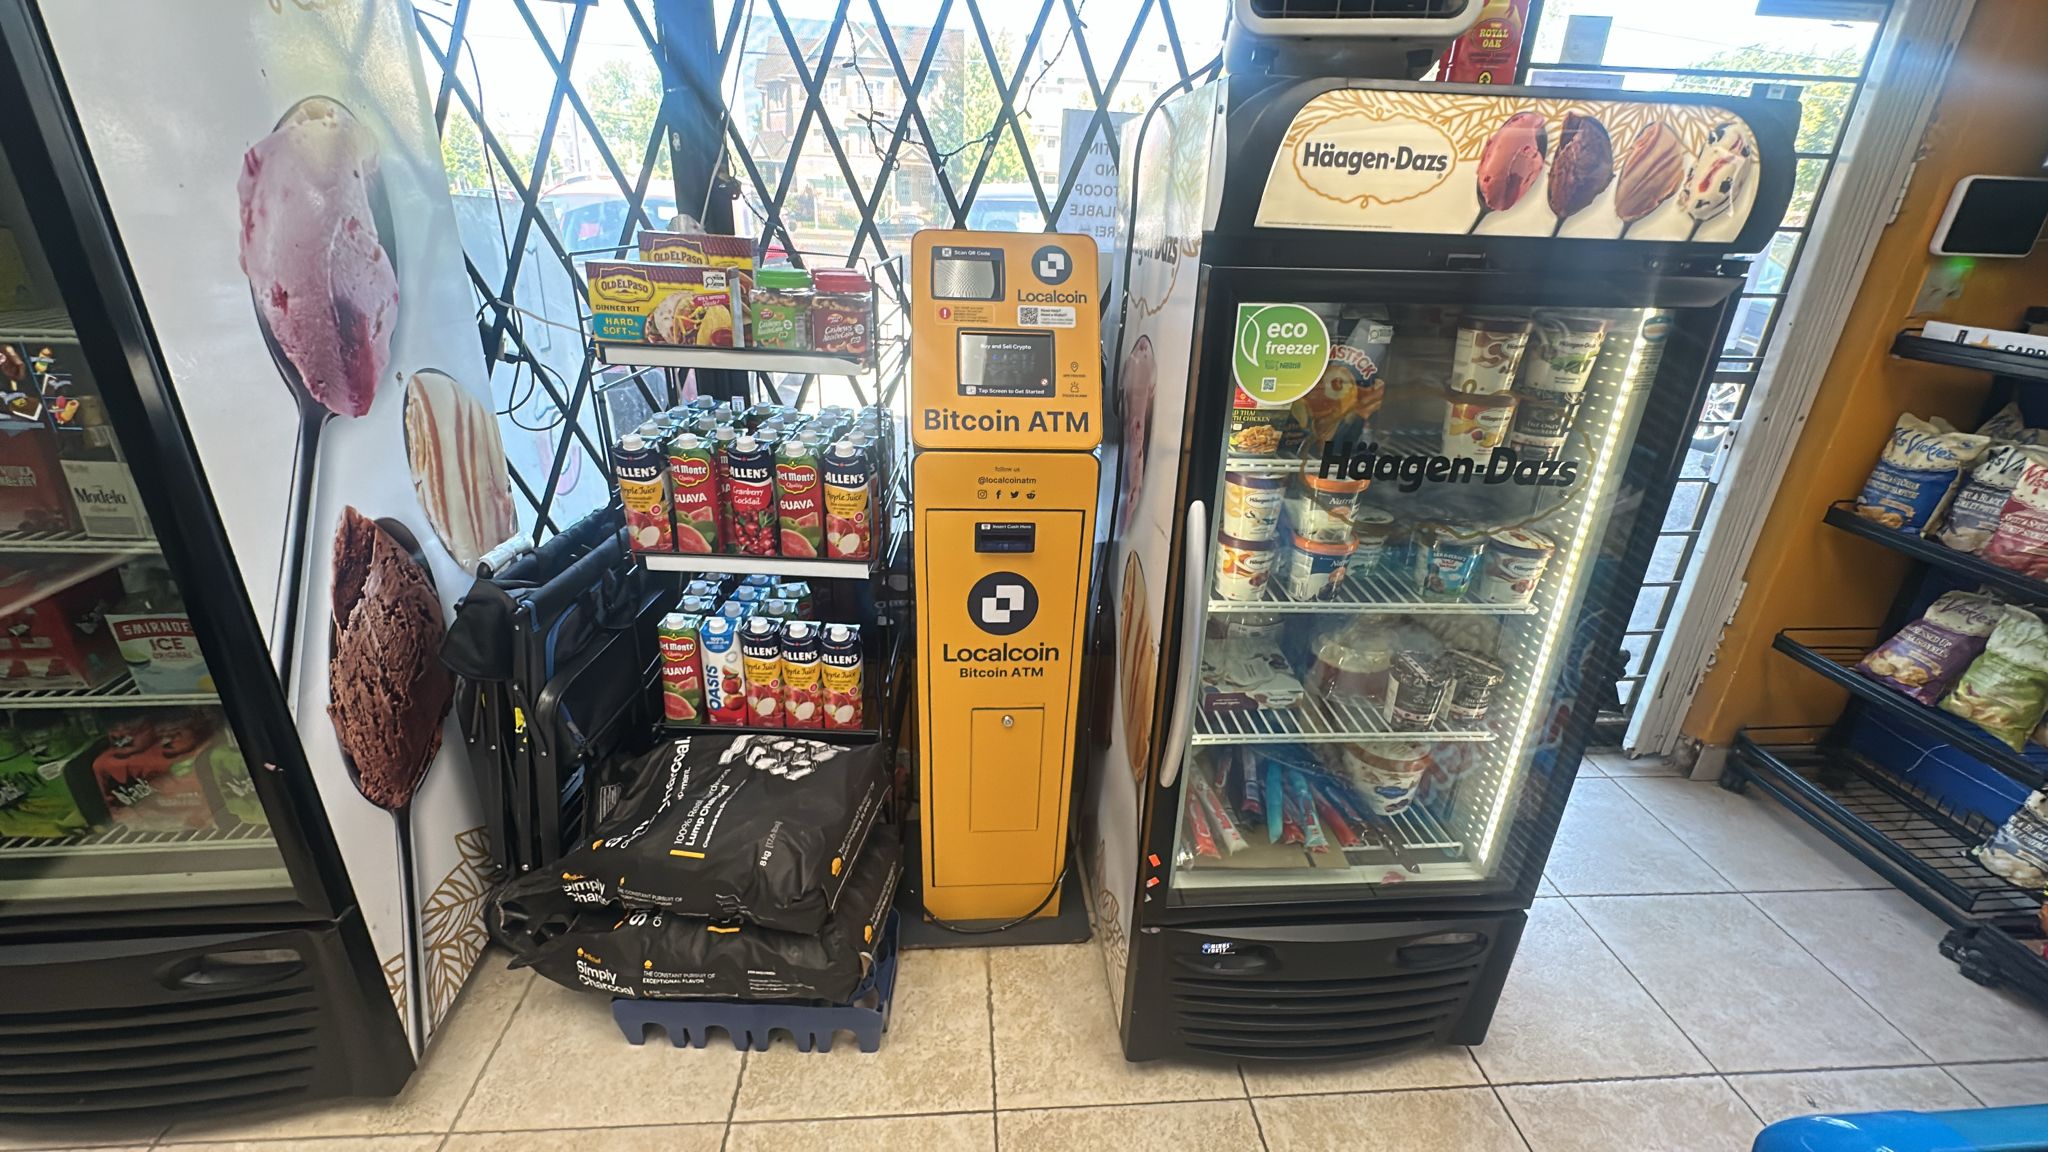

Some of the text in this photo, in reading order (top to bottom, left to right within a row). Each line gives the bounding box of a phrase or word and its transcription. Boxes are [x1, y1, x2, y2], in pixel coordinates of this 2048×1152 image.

[1480, 29, 1509, 38] ROYAL
[1482, 39, 1502, 48] OAK
[1302, 142, 1448, 175] Häagen-Dazs
[601, 280, 619, 292] OLD
[618, 279, 629, 289] EL
[1017, 289, 1088, 304] Localcoin
[595, 304, 640, 313] DINNER KIT
[605, 317, 634, 326] HARD
[603, 326, 627, 335] SOFT
[1266, 322, 1309, 338] eco
[1265, 340, 1320, 356] freezer
[924, 408, 1089, 433] Bitcoin ATM
[616, 465, 657, 478] ALLEN'S
[681, 465, 707, 475] Monte
[729, 466, 768, 479] ALLEN'S
[1319, 441, 1579, 493] Häagen-Dazs
[788, 471, 815, 482] Monte
[825, 472, 865, 484] ALLEN'S
[977, 477, 1037, 485] @localcoinatm
[74, 487, 128, 505] Modelo
[639, 485, 656, 495] Juice
[733, 486, 764, 497] Cranberry
[674, 492, 708, 504] GUAVA
[734, 496, 762, 506] Cocktail
[847, 492, 863, 501] Juice
[779, 499, 815, 511] GUAVA
[121, 622, 192, 636] SMIRNOF
[149, 638, 187, 651] ICE
[669, 643, 694, 652] Monte
[743, 645, 778, 656] ALLEN'S
[782, 650, 818, 661] ALLEN'S
[943, 642, 1059, 663] Localcoin
[822, 653, 858, 665] ALLEN'S
[662, 665, 694, 676] GUAVA
[801, 667, 816, 675] Juice
[959, 667, 1044, 678] Bitcoin ATM
[705, 665, 722, 710] OASIS
[674, 818, 693, 845] 100%
[685, 816, 706, 846] Lump
[762, 850, 772, 860] kg
[563, 878, 606, 895] Simply
[625, 890, 652, 899] CONSTANT
[576, 960, 617, 985] Simply
[579, 974, 636, 997] Charcoal
